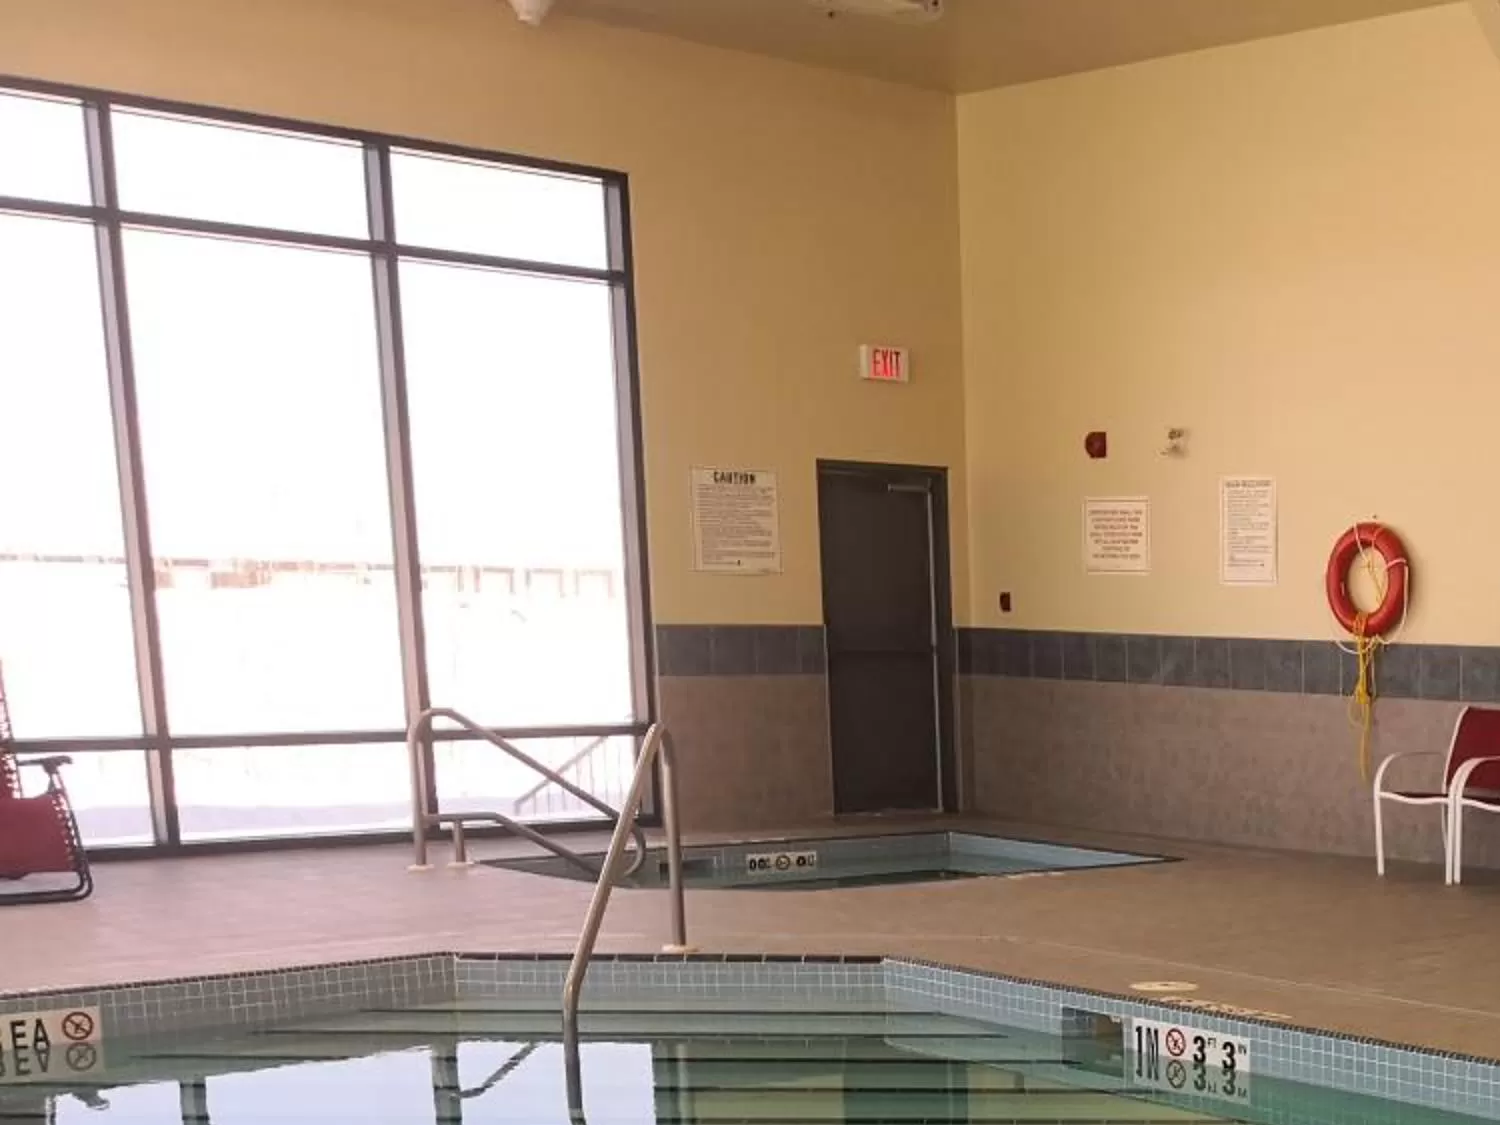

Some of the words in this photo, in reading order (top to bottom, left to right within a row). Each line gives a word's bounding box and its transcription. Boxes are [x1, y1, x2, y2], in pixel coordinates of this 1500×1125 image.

[873, 349, 901, 377] EXIT
[713, 471, 756, 485] CAUTION
[0, 1017, 51, 1049] EA
